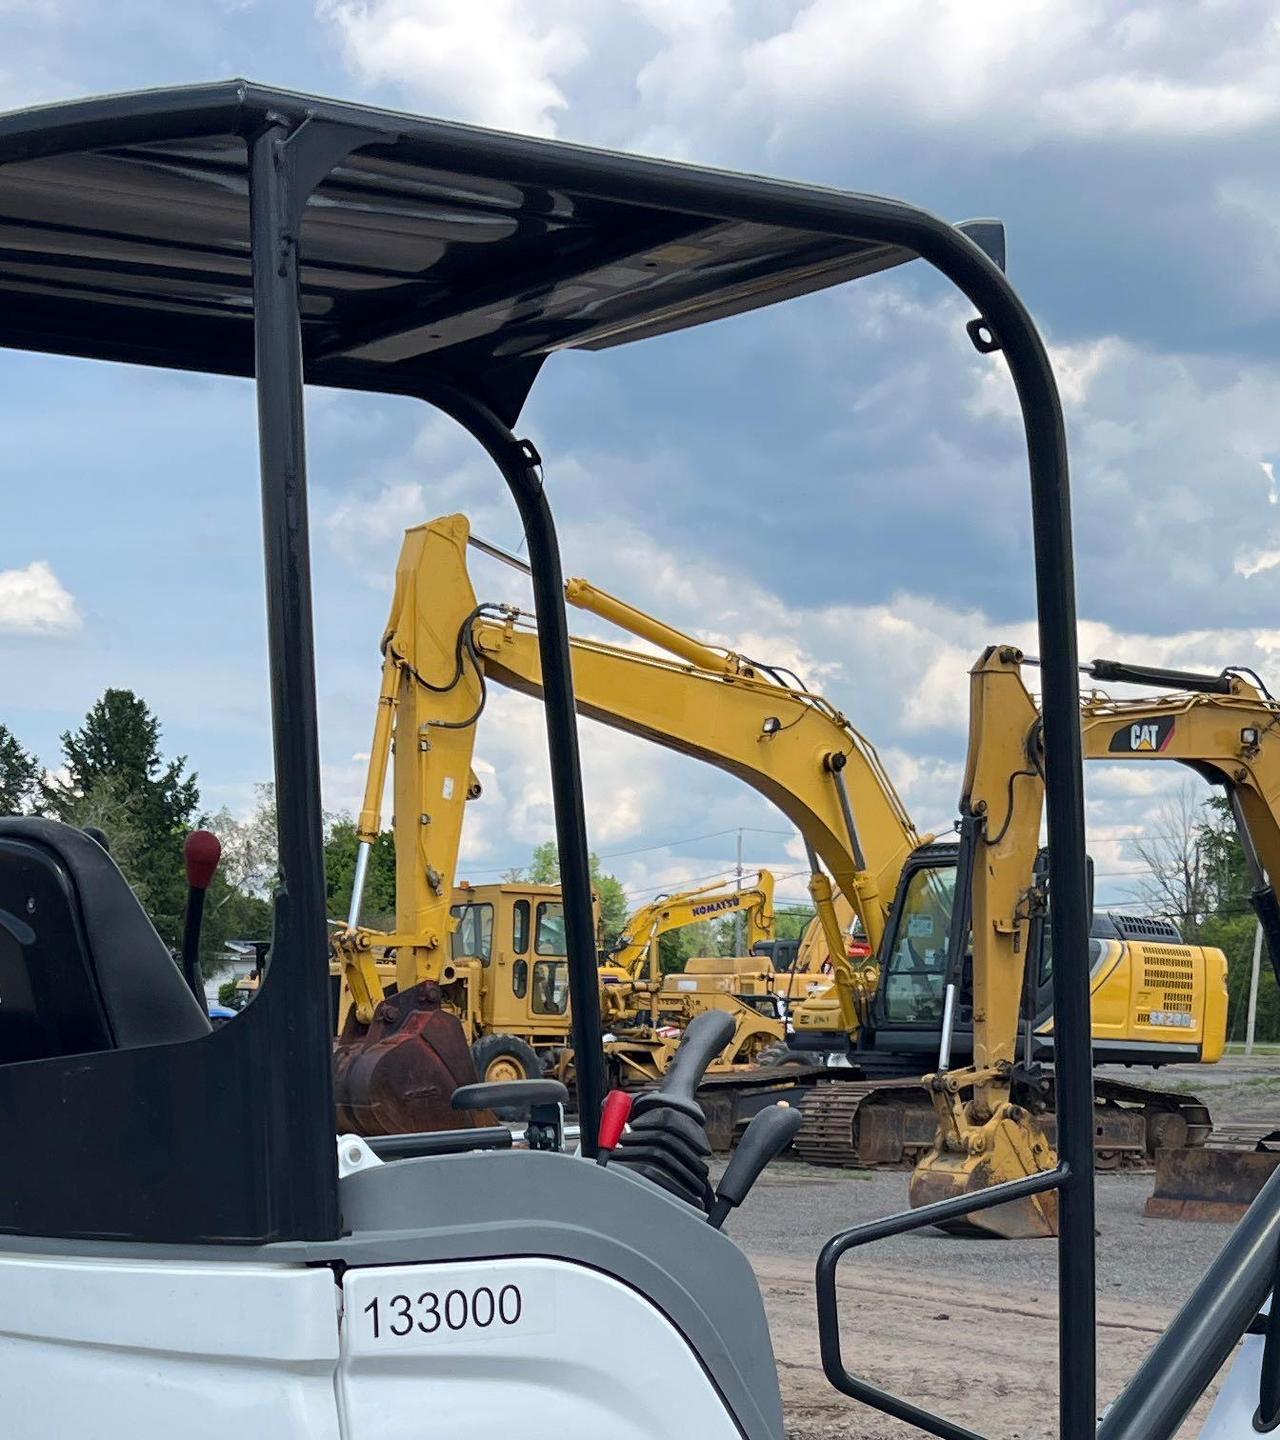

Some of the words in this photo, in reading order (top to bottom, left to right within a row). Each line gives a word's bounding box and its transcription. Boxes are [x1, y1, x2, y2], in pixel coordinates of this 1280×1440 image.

[1130, 724, 1159, 750] CAT
[692, 895, 740, 917] KOMATSU
[364, 1284, 522, 1338] 133000
